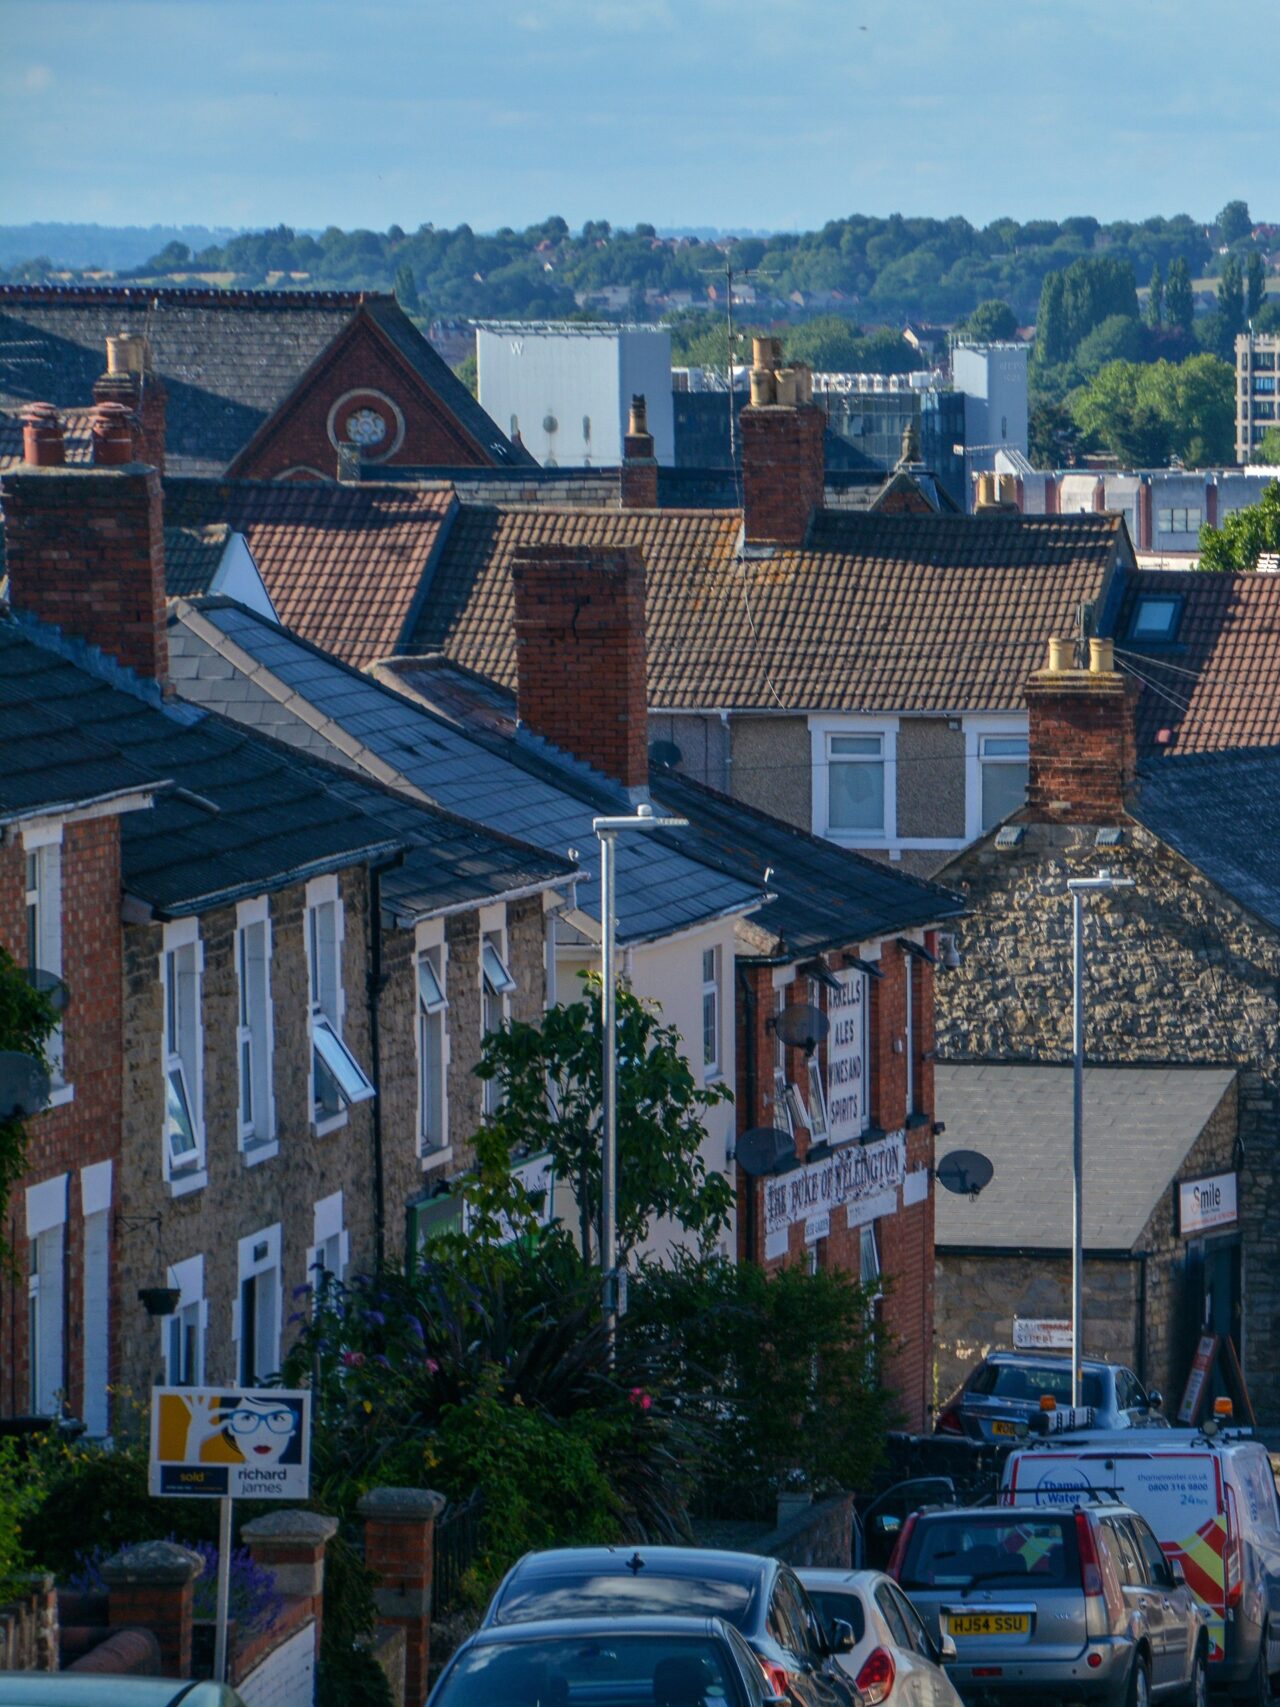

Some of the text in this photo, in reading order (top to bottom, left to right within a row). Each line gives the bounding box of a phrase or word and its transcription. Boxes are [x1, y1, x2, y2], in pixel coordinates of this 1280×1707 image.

[834, 1019, 854, 1047] ALES
[828, 1056, 862, 1088] WINES AND
[830, 1095, 858, 1125] SPIRITS
[767, 1184, 787, 1218] THE
[790, 1171, 818, 1208] DUKE
[821, 1167, 832, 1197] OF
[1192, 1182, 1221, 1210] Smile
[180, 1471, 204, 1482] sold
[238, 1468, 287, 1480] richard
[241, 1482, 282, 1495] james
[1043, 1480, 1085, 1491] Thames
[1148, 1483, 1168, 1492] 0800
[1048, 1492, 1081, 1504] Water
[953, 1616, 1023, 1633] HJ54 SSU
